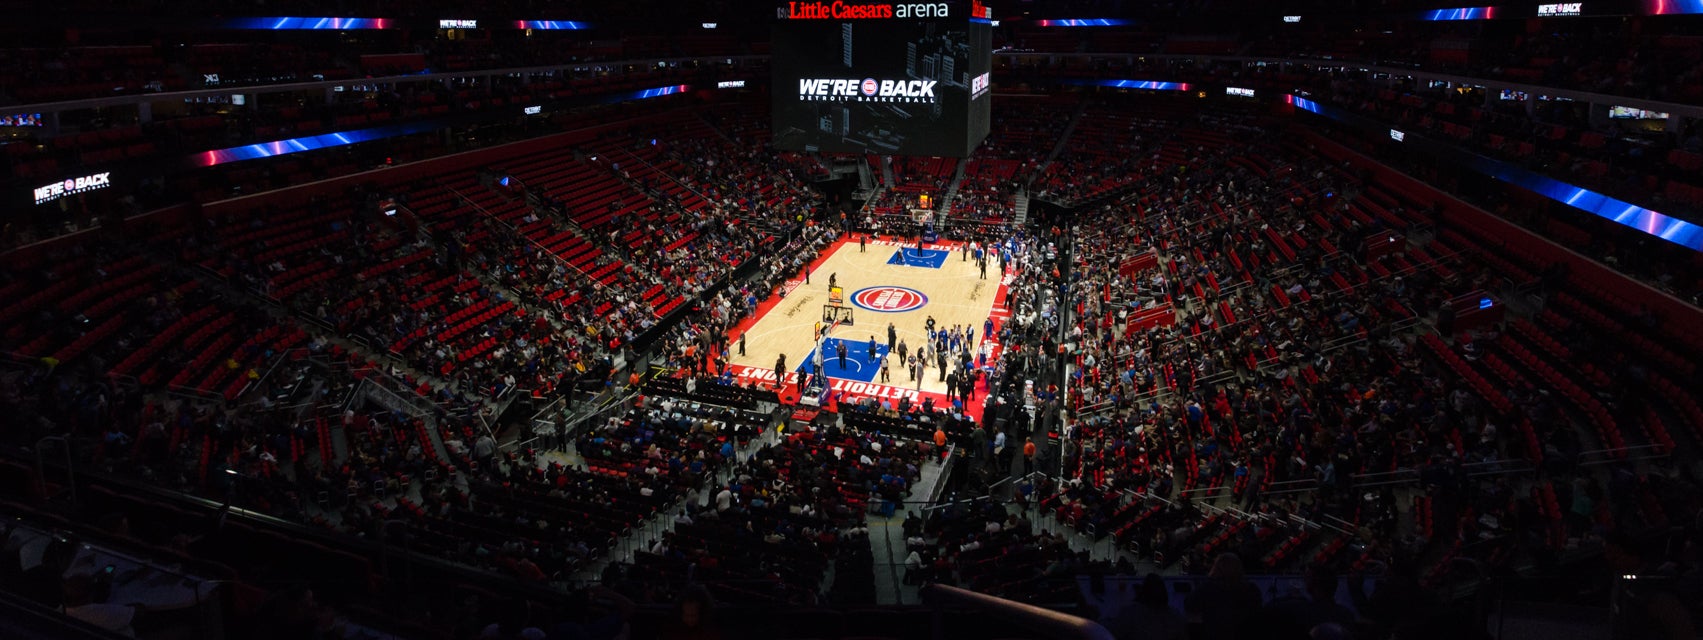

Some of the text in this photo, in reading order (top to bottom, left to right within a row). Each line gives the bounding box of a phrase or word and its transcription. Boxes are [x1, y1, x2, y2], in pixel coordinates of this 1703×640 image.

[789, 1, 829, 19] Little
[831, 1, 892, 19] Caesars
[896, 3, 948, 18] arena
[1562, 3, 1582, 13] BACK
[800, 79, 937, 97] WE'RE BACK
[75, 172, 110, 189] BACK
